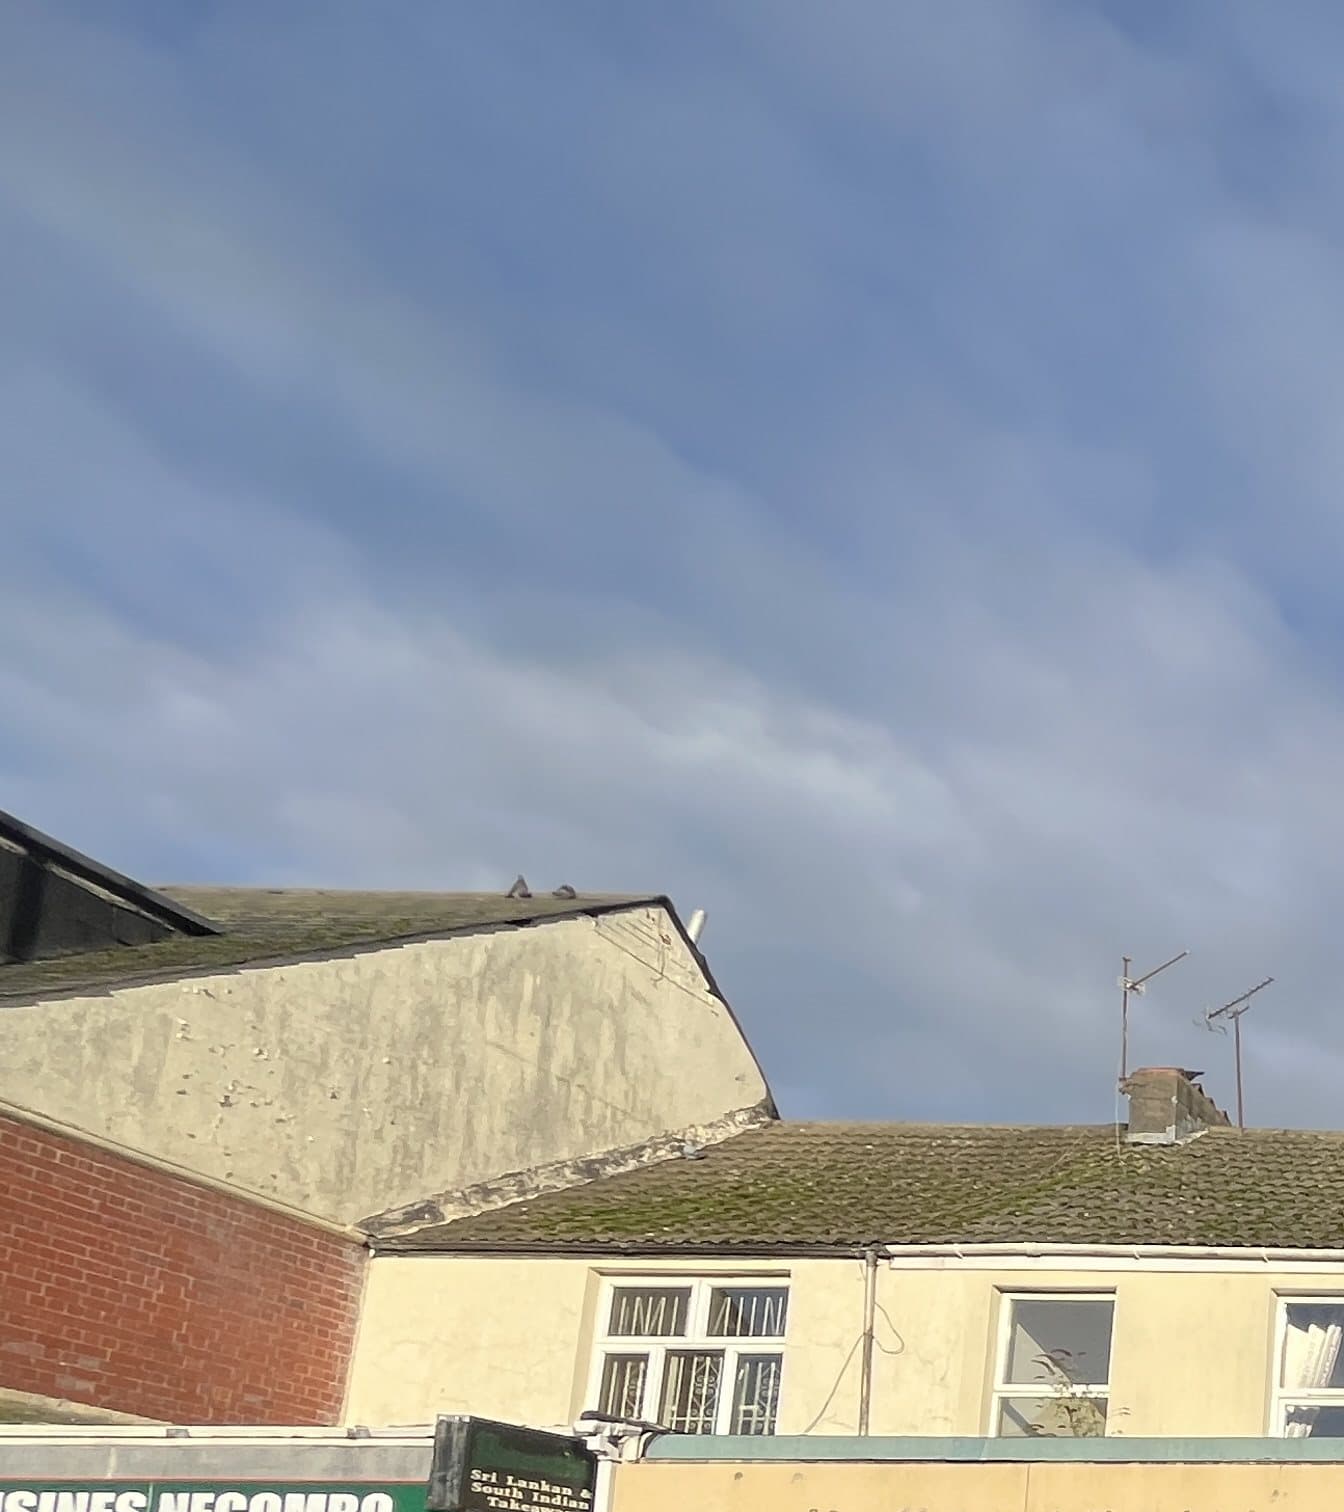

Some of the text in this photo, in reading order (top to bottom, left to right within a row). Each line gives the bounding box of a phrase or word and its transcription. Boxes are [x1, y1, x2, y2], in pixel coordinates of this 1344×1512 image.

[470, 1469, 593, 1499] Sri Lankan &
[471, 1482, 590, 1510] South Indian
